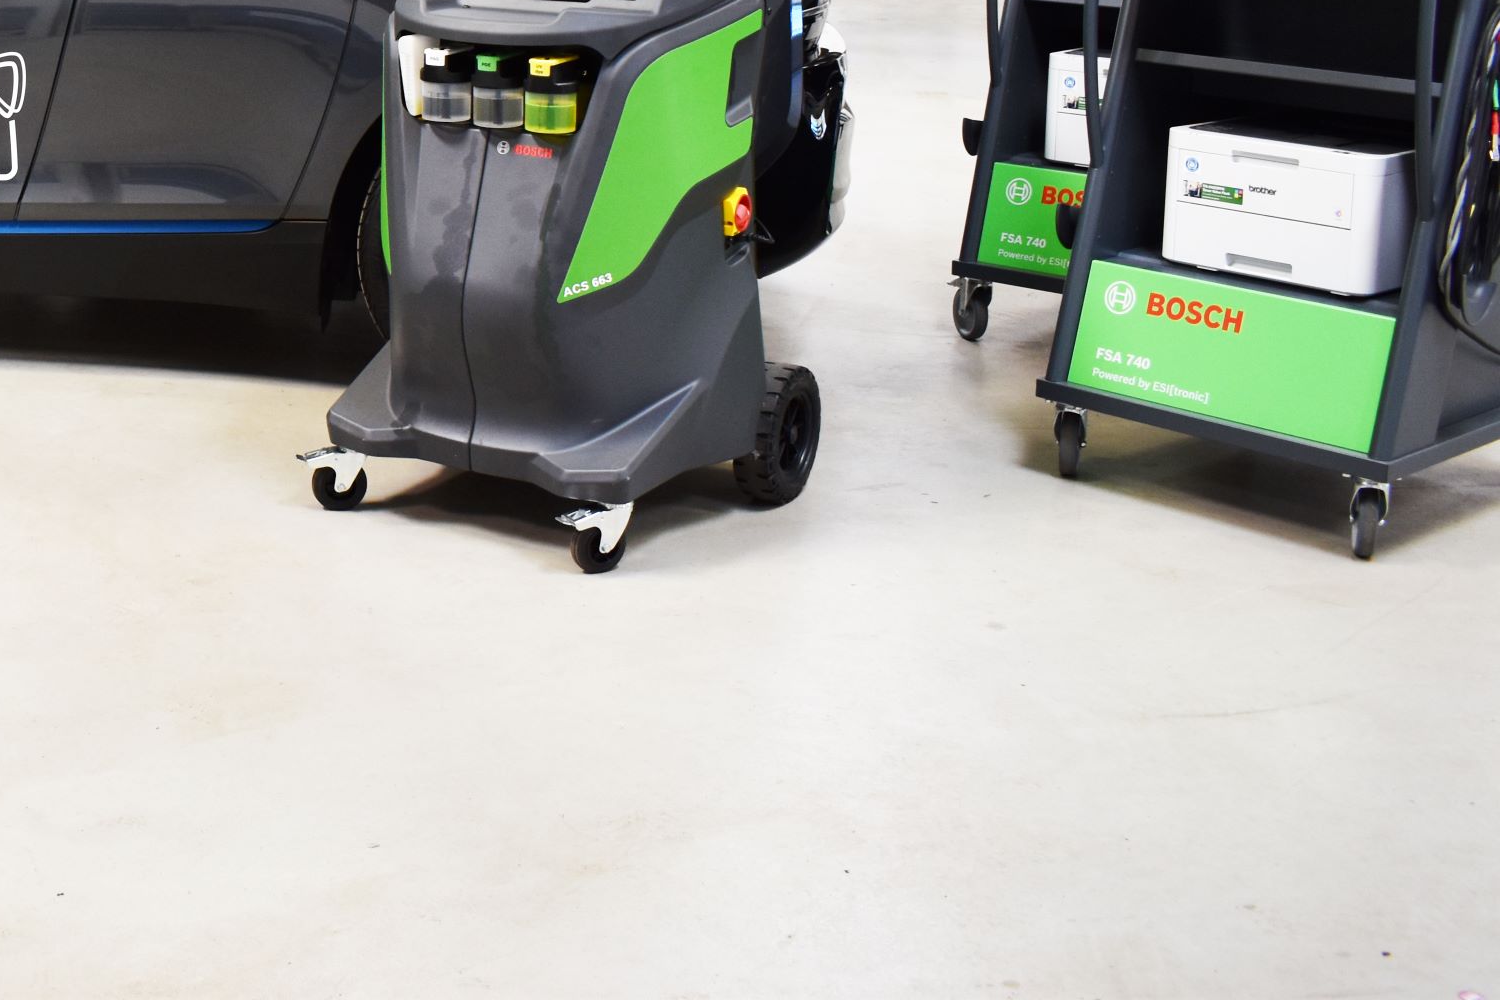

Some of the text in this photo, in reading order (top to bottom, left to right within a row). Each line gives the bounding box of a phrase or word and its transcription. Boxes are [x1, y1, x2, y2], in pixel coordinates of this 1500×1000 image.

[514, 143, 553, 159] BOSCH
[1041, 185, 1085, 209] BOS
[1248, 185, 1277, 196] brother
[1000, 232, 1047, 249] FSA 740
[997, 248, 1035, 262] Powered
[1036, 255, 1048, 266] by
[563, 272, 613, 297] ACS 663
[1146, 292, 1244, 334] BOSCH
[1095, 346, 1152, 370] FSA 740
[1092, 367, 1210, 405] Powered by ESI[tronic]
